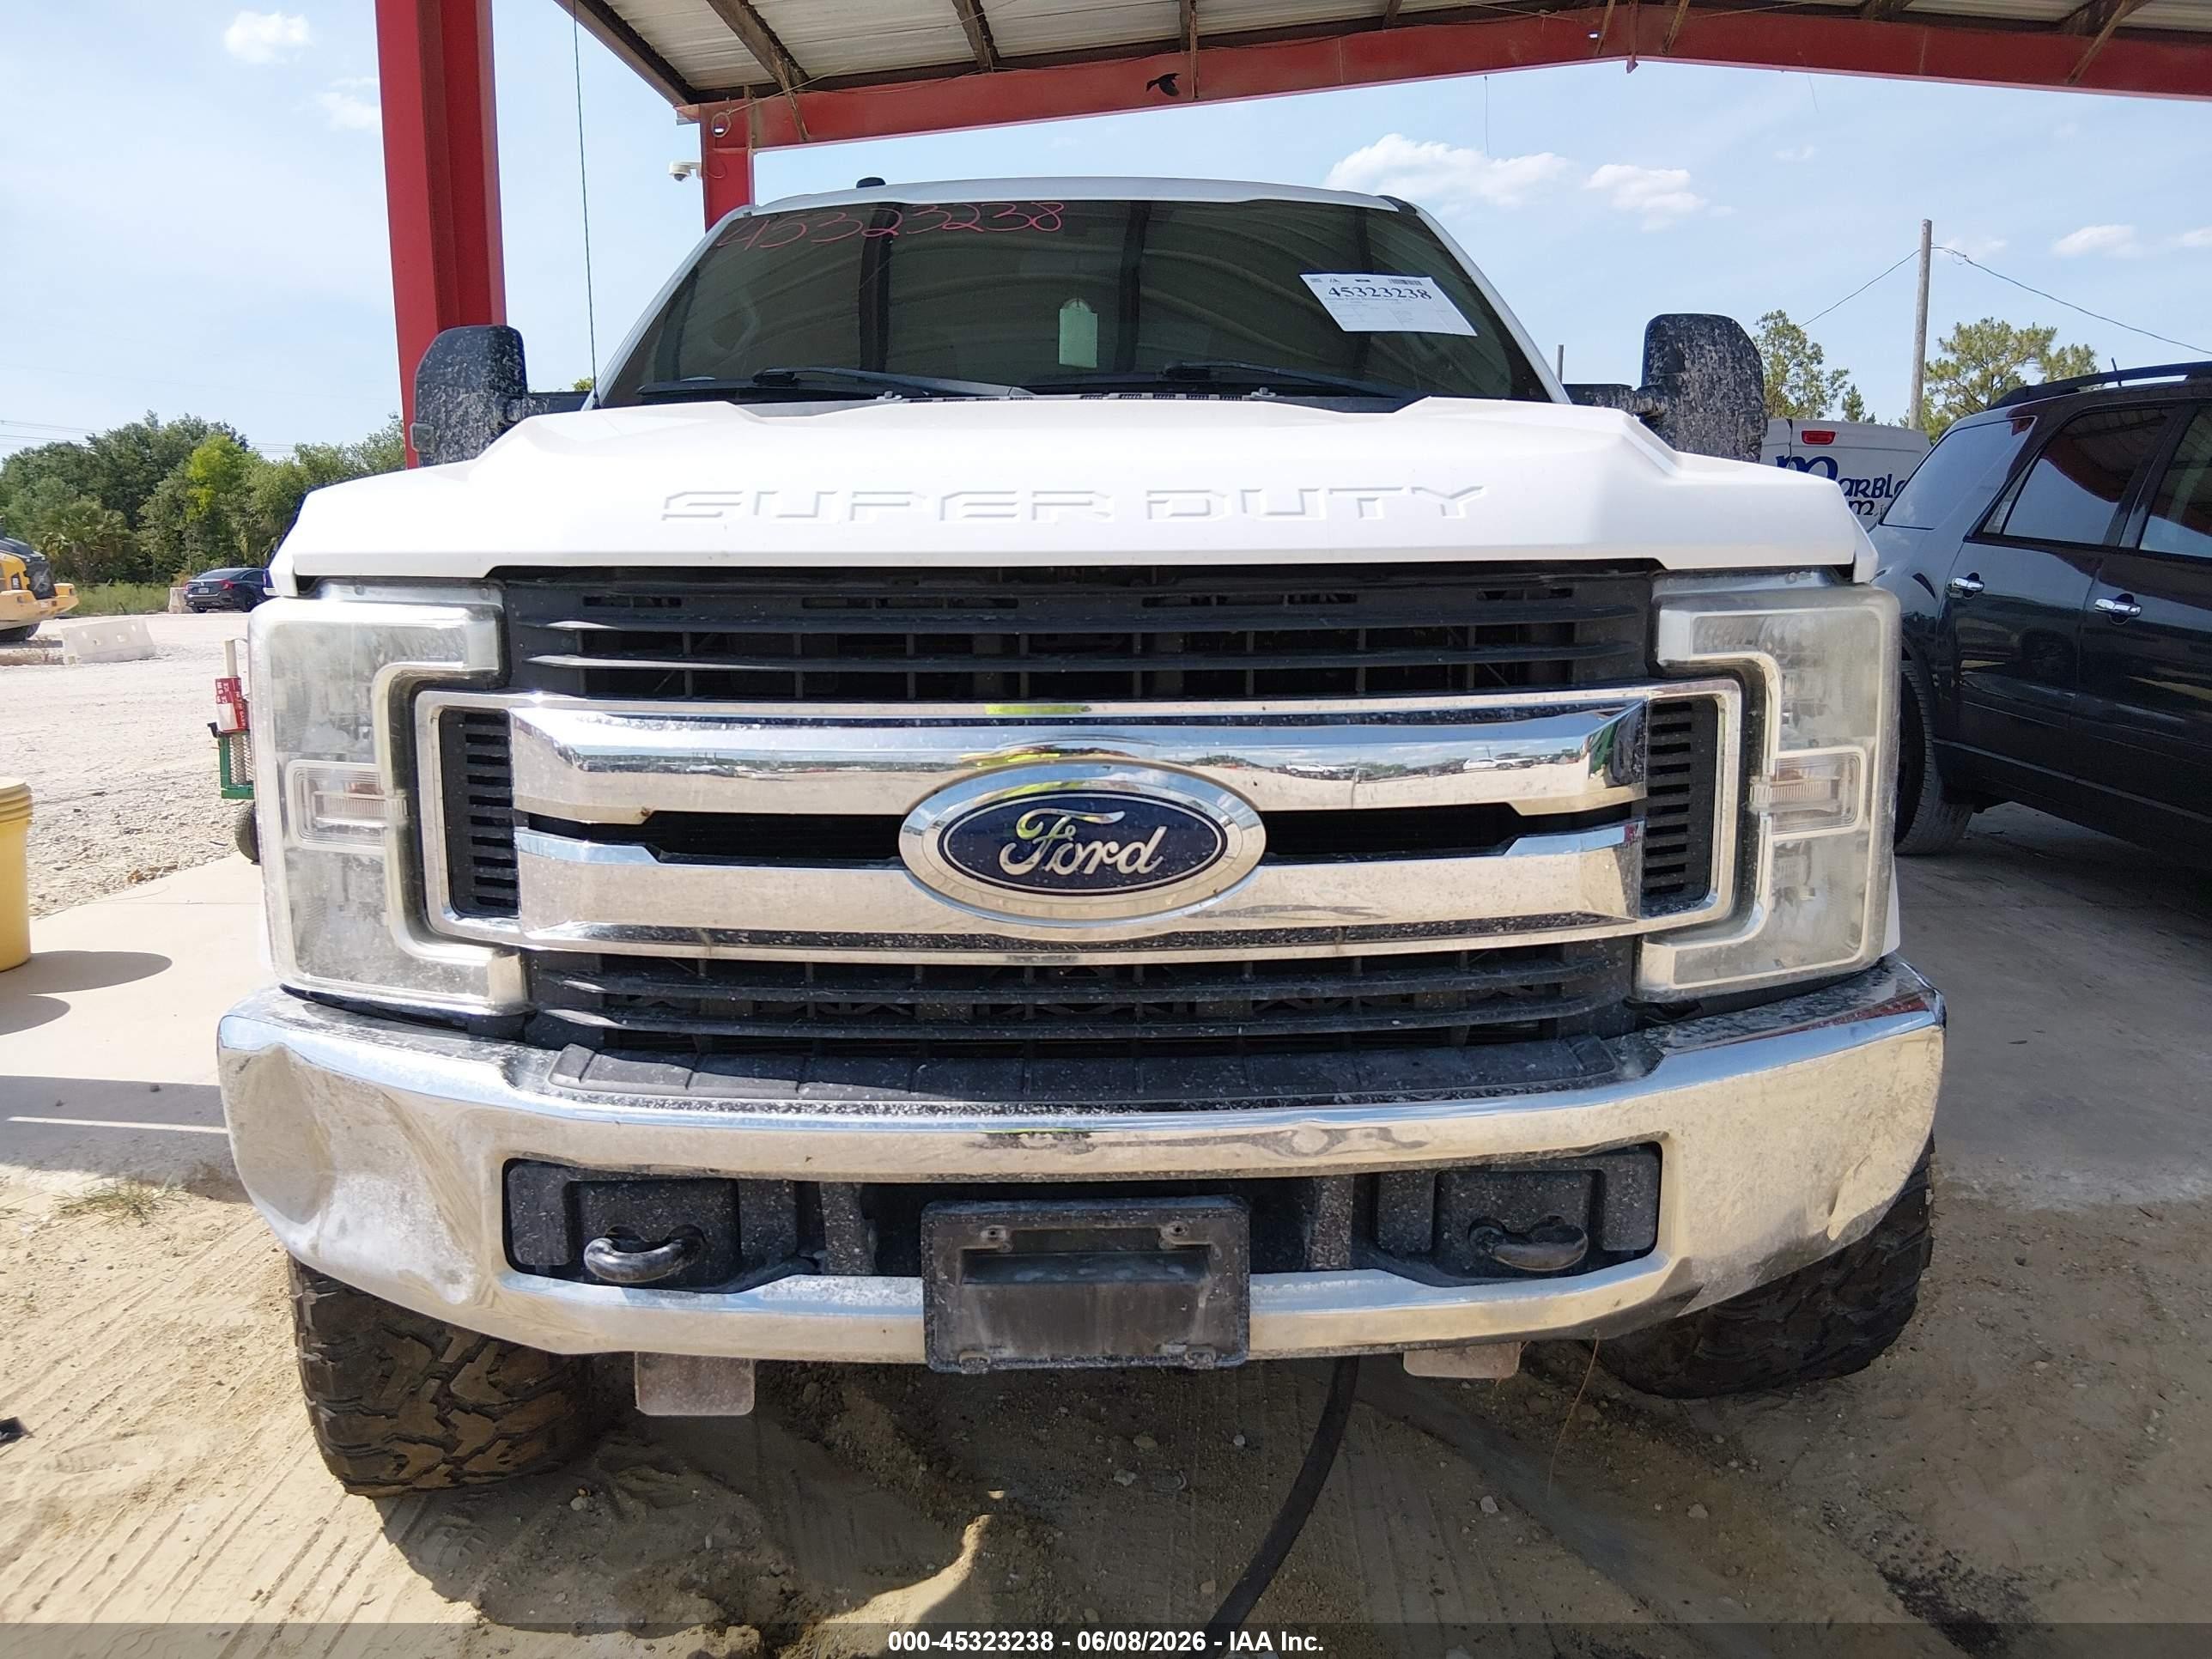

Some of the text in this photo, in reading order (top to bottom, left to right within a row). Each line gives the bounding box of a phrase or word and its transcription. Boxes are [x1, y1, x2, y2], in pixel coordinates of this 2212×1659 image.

[717, 202, 1064, 250] 45323238
[1328, 287, 1431, 300] 45323238
[661, 486, 1486, 523] SUPER DUTY
[999, 808, 1167, 876] Ford
